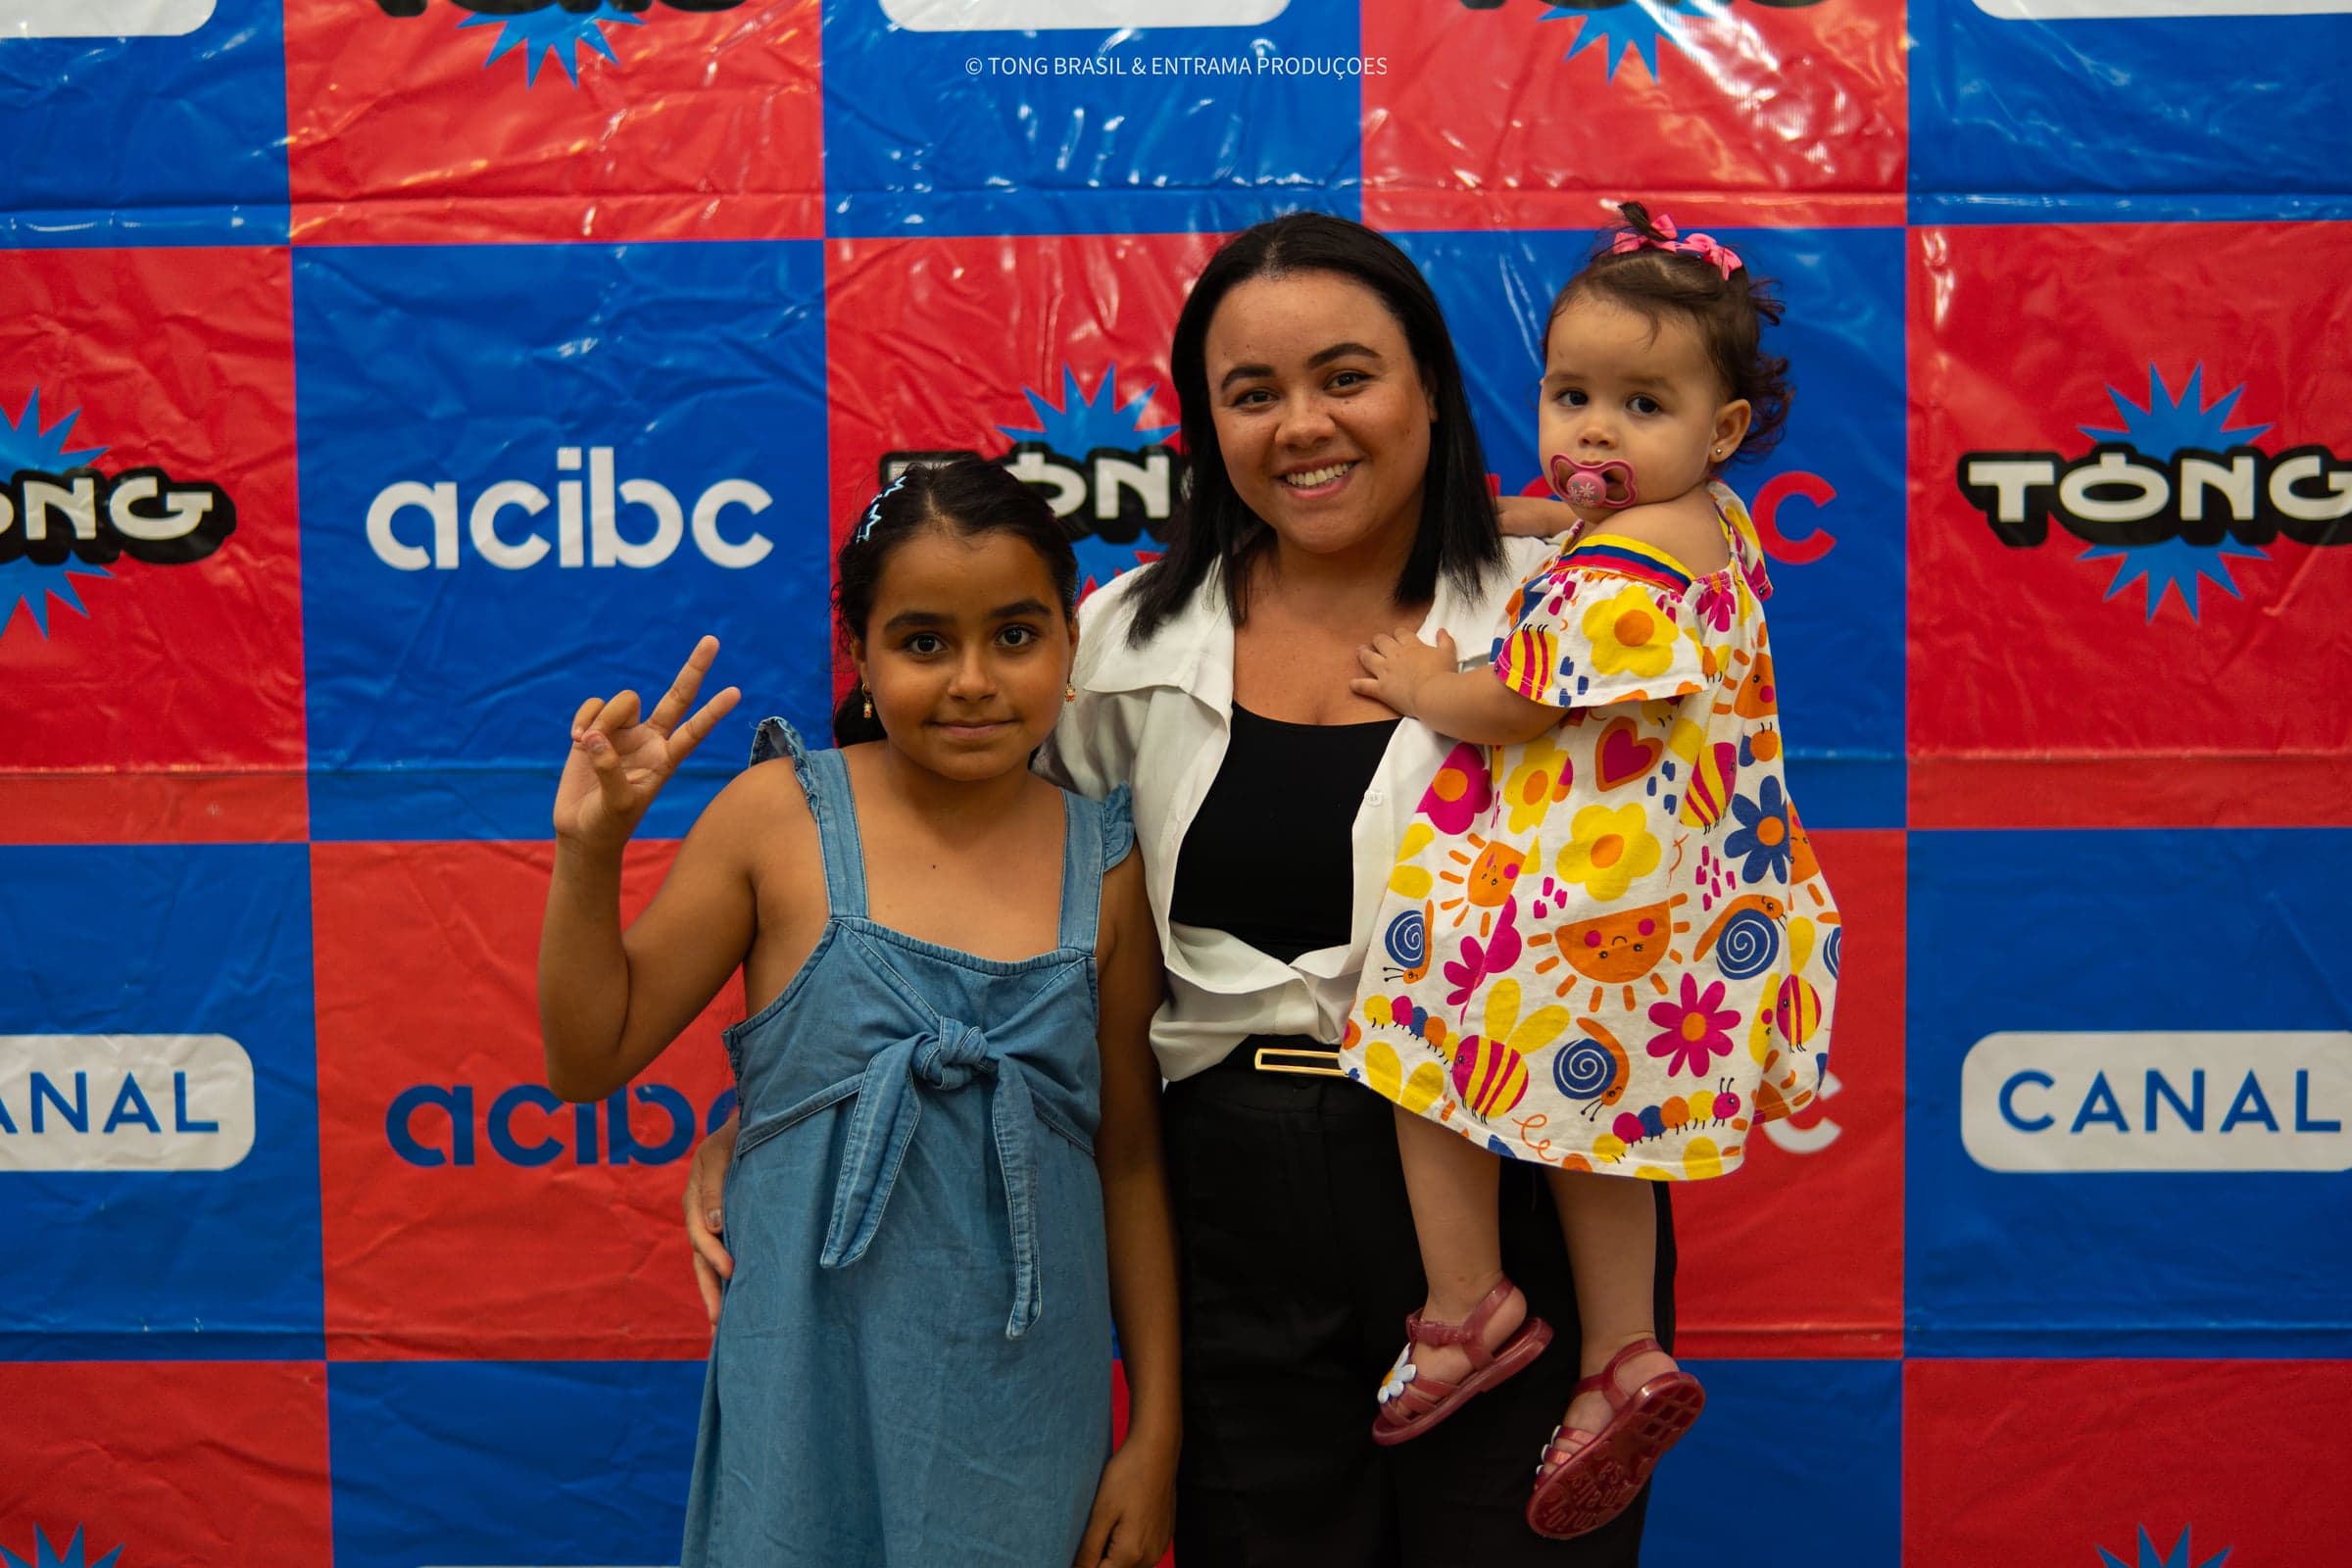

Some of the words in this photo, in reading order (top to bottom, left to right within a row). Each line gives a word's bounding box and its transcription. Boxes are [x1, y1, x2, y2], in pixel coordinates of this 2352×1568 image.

[0, 476, 214, 541] NG
[366, 447, 775, 570] acibc
[888, 451, 1194, 519] ON
[1998, 1068, 2342, 1134] CANAL
